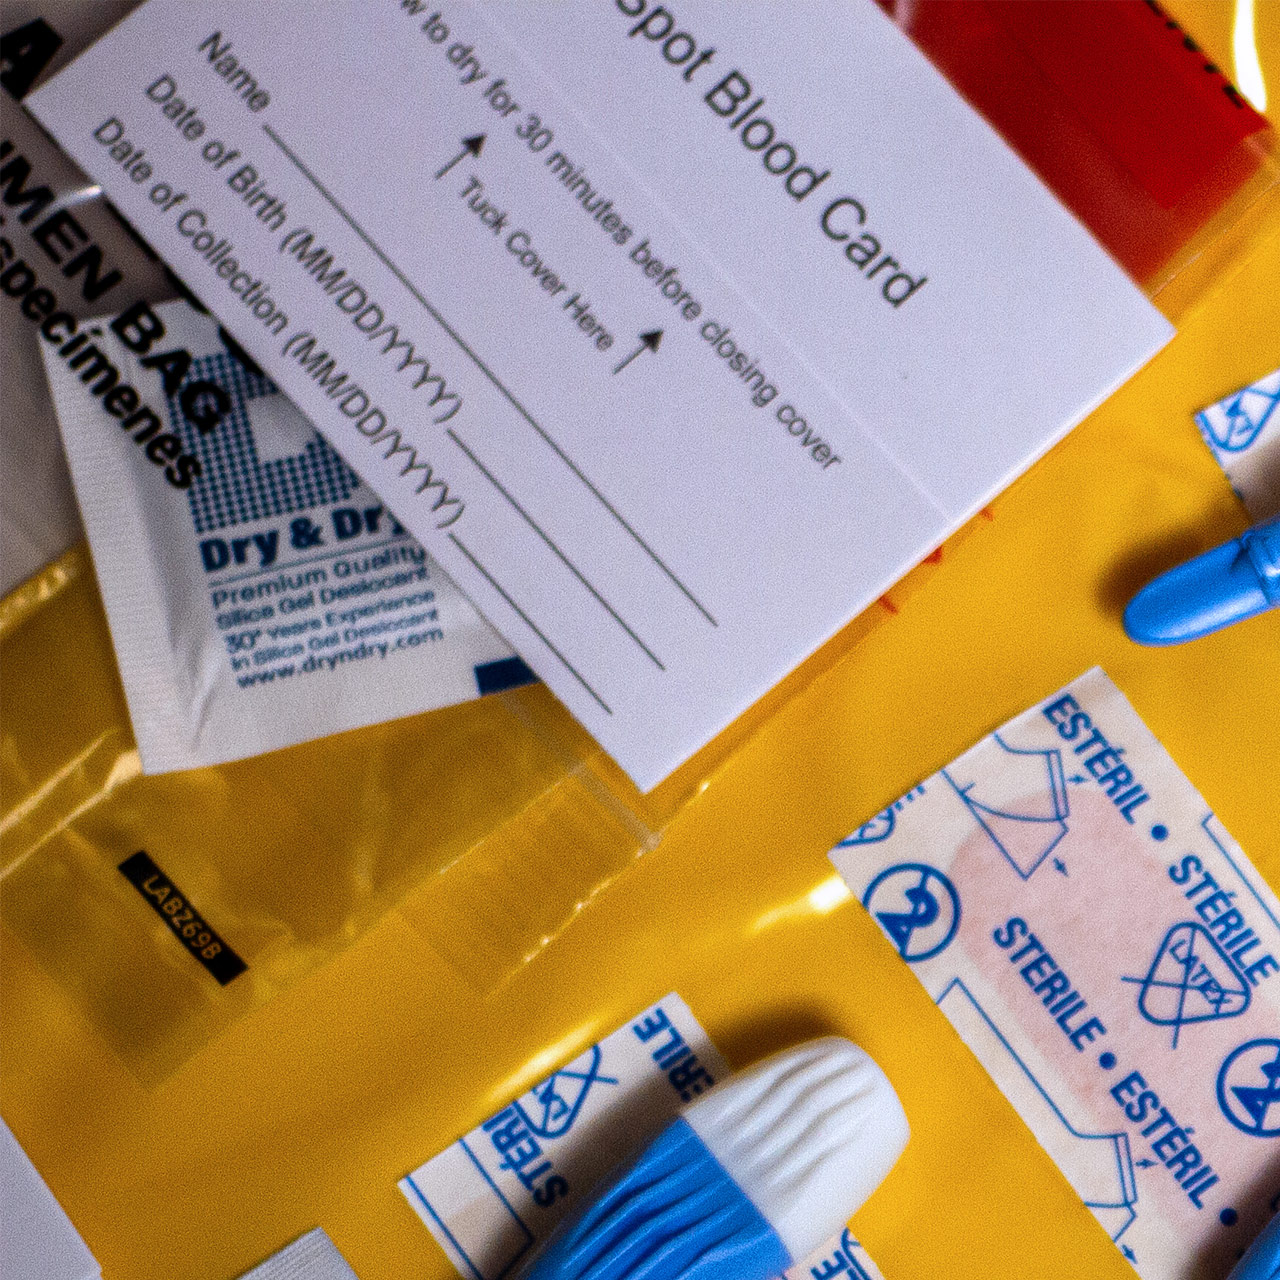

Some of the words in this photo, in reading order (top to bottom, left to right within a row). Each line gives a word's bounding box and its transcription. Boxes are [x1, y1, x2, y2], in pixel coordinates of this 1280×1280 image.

[196, 29, 273, 113] Name
[143, 72, 208, 142] Date
[200, 136, 240, 171] of
[226, 164, 289, 231] Birth
[276, 225, 464, 425] (MM/DD/YYYY)
[419, 10, 452, 45] to
[443, 40, 489, 87] dry
[481, 77, 521, 119] for
[513, 112, 554, 153] 30
[544, 149, 635, 246] minutes
[628, 238, 704, 321] before
[695, 317, 781, 409] closing
[774, 401, 842, 470] cover
[458, 175, 510, 236] Tuck
[503, 229, 569, 298] Cover
[562, 292, 616, 352] Here
[702, 68, 830, 202] Blood
[816, 193, 928, 309] Card
[91, 115, 155, 185] Date
[147, 179, 188, 214] of
[174, 206, 292, 336] Collection
[279, 328, 467, 530] (MM/DD/YYYY)
[108, 298, 235, 437] BAG
[198, 527, 281, 576] Dry
[288, 515, 324, 550] &
[210, 567, 327, 609] Premium
[332, 543, 427, 579] Quality
[1043, 693, 1151, 826] ESTÉRIL
[994, 918, 1106, 1051] STERILE
[1111, 1071, 1220, 1210] ESTÉRIL
